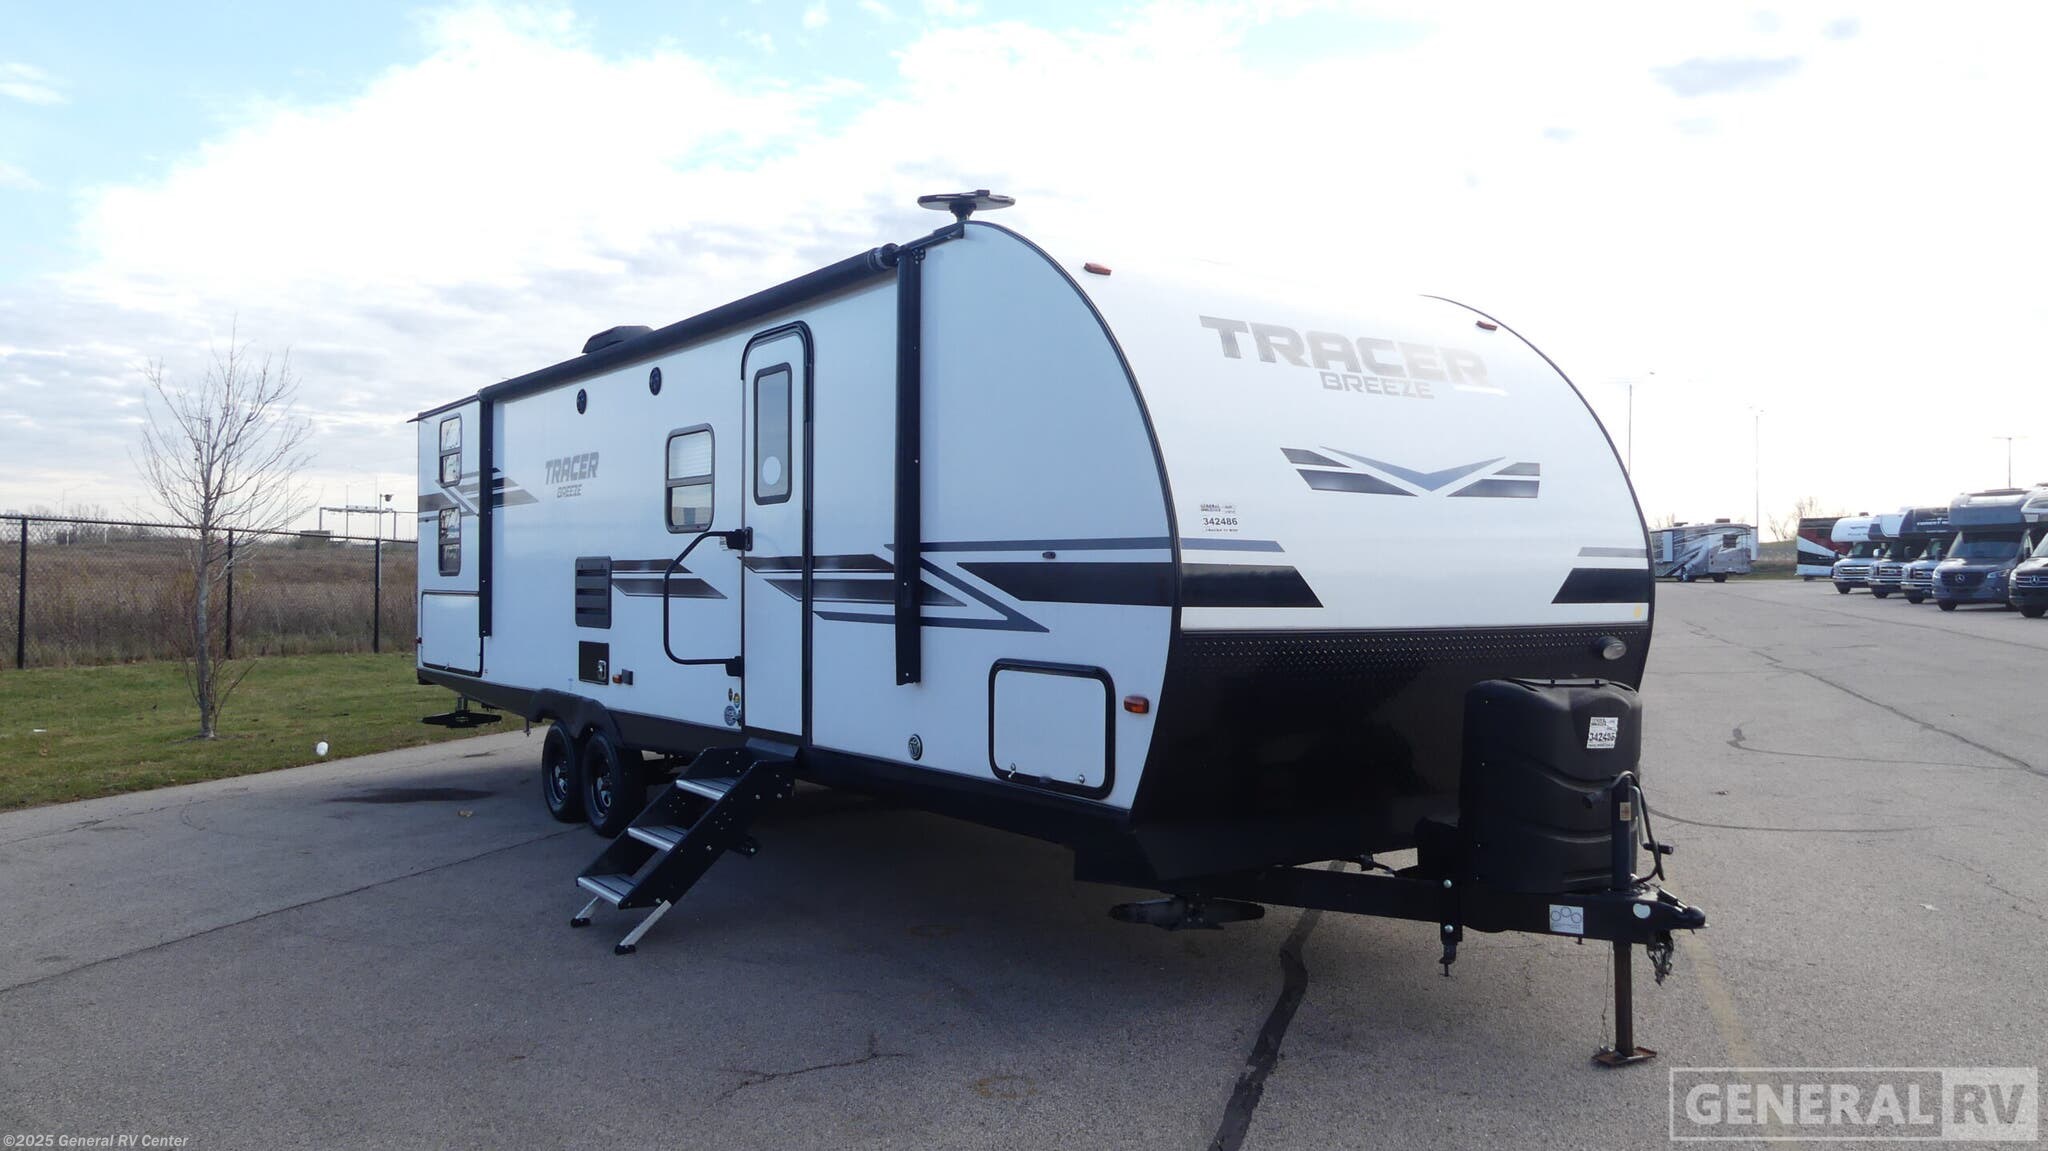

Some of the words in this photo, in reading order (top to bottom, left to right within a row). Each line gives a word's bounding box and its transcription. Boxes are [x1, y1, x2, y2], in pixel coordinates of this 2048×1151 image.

[1199, 315, 1490, 385] TRACER
[1319, 371, 1435, 399] BREEZE
[545, 451, 599, 485] TRACER
[556, 484, 583, 498] BREEZE
[1202, 517, 1238, 526] 342486
